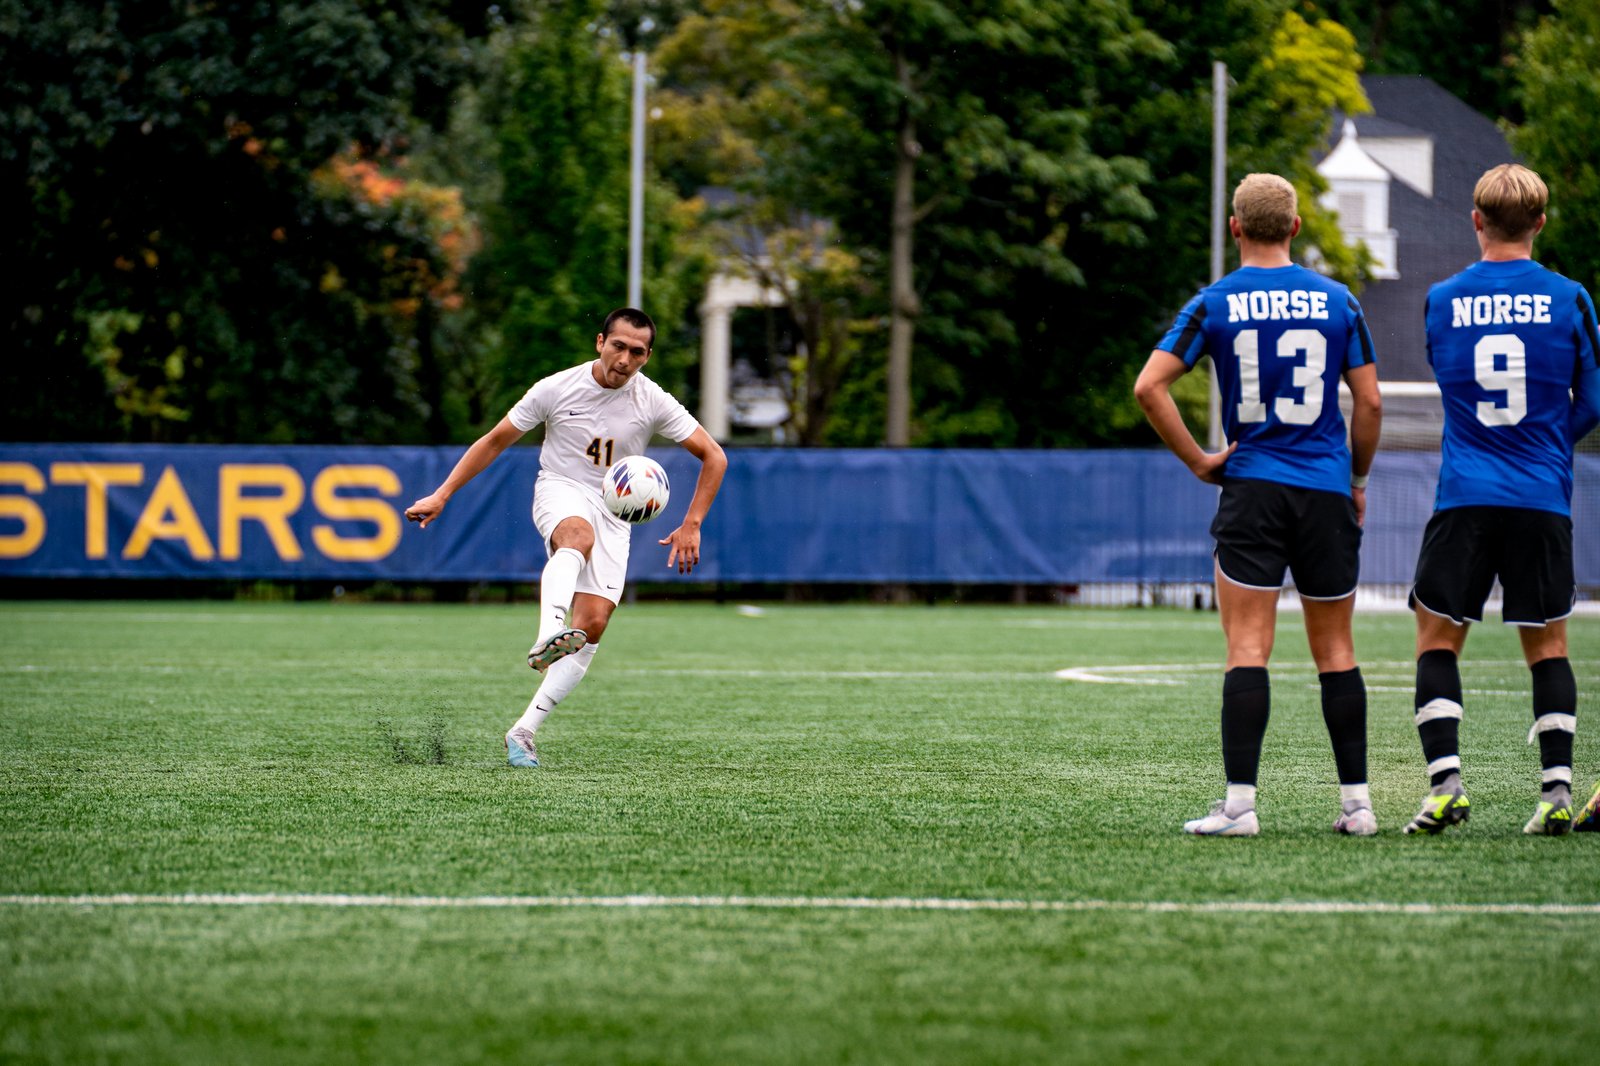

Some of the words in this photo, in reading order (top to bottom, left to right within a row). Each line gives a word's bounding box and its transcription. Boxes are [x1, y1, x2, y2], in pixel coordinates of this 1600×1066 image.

[1227, 290, 1329, 322] NORSE
[1452, 294, 1552, 328] NORSE
[1234, 328, 1327, 425] 13
[1474, 333, 1528, 428] 9
[586, 437, 615, 467] 41
[0, 462, 403, 562] STARS
